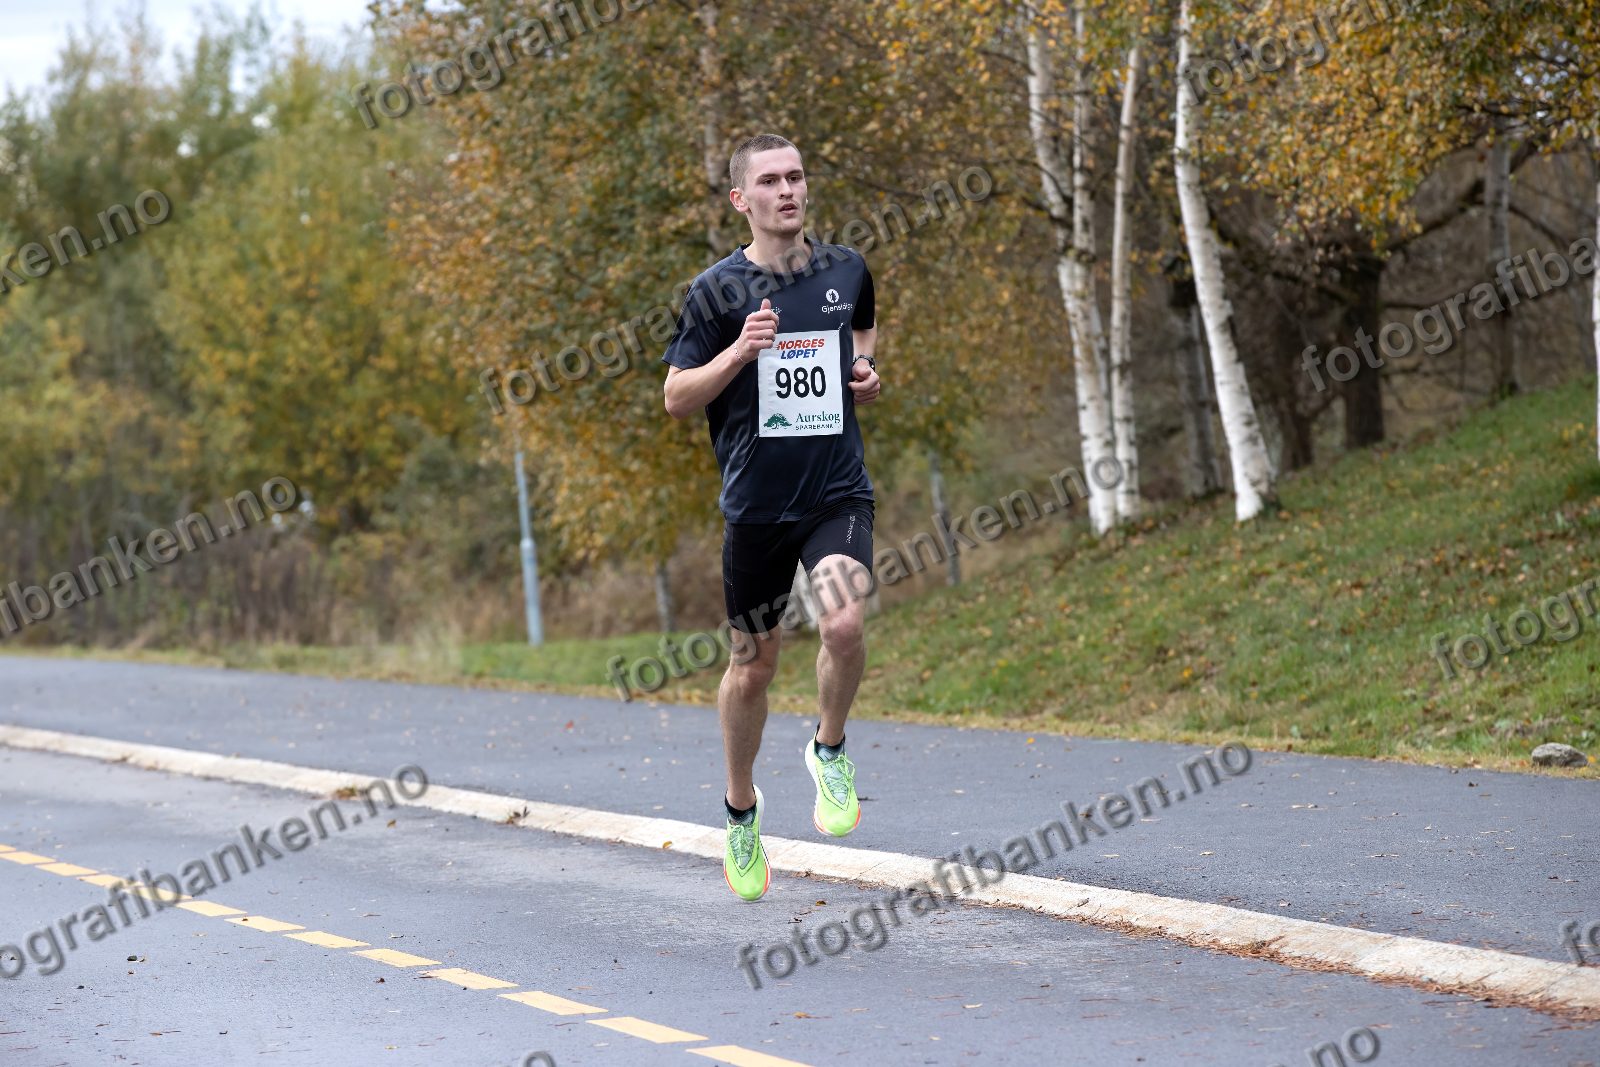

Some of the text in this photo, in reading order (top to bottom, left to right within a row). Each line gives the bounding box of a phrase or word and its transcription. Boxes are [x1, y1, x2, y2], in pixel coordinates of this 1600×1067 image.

[777, 338, 825, 350] NORGES
[780, 348, 818, 360] LØPET
[775, 365, 827, 399] 980
[795, 410, 841, 424] Aurskog
[795, 423, 834, 431] SPAREBANK
